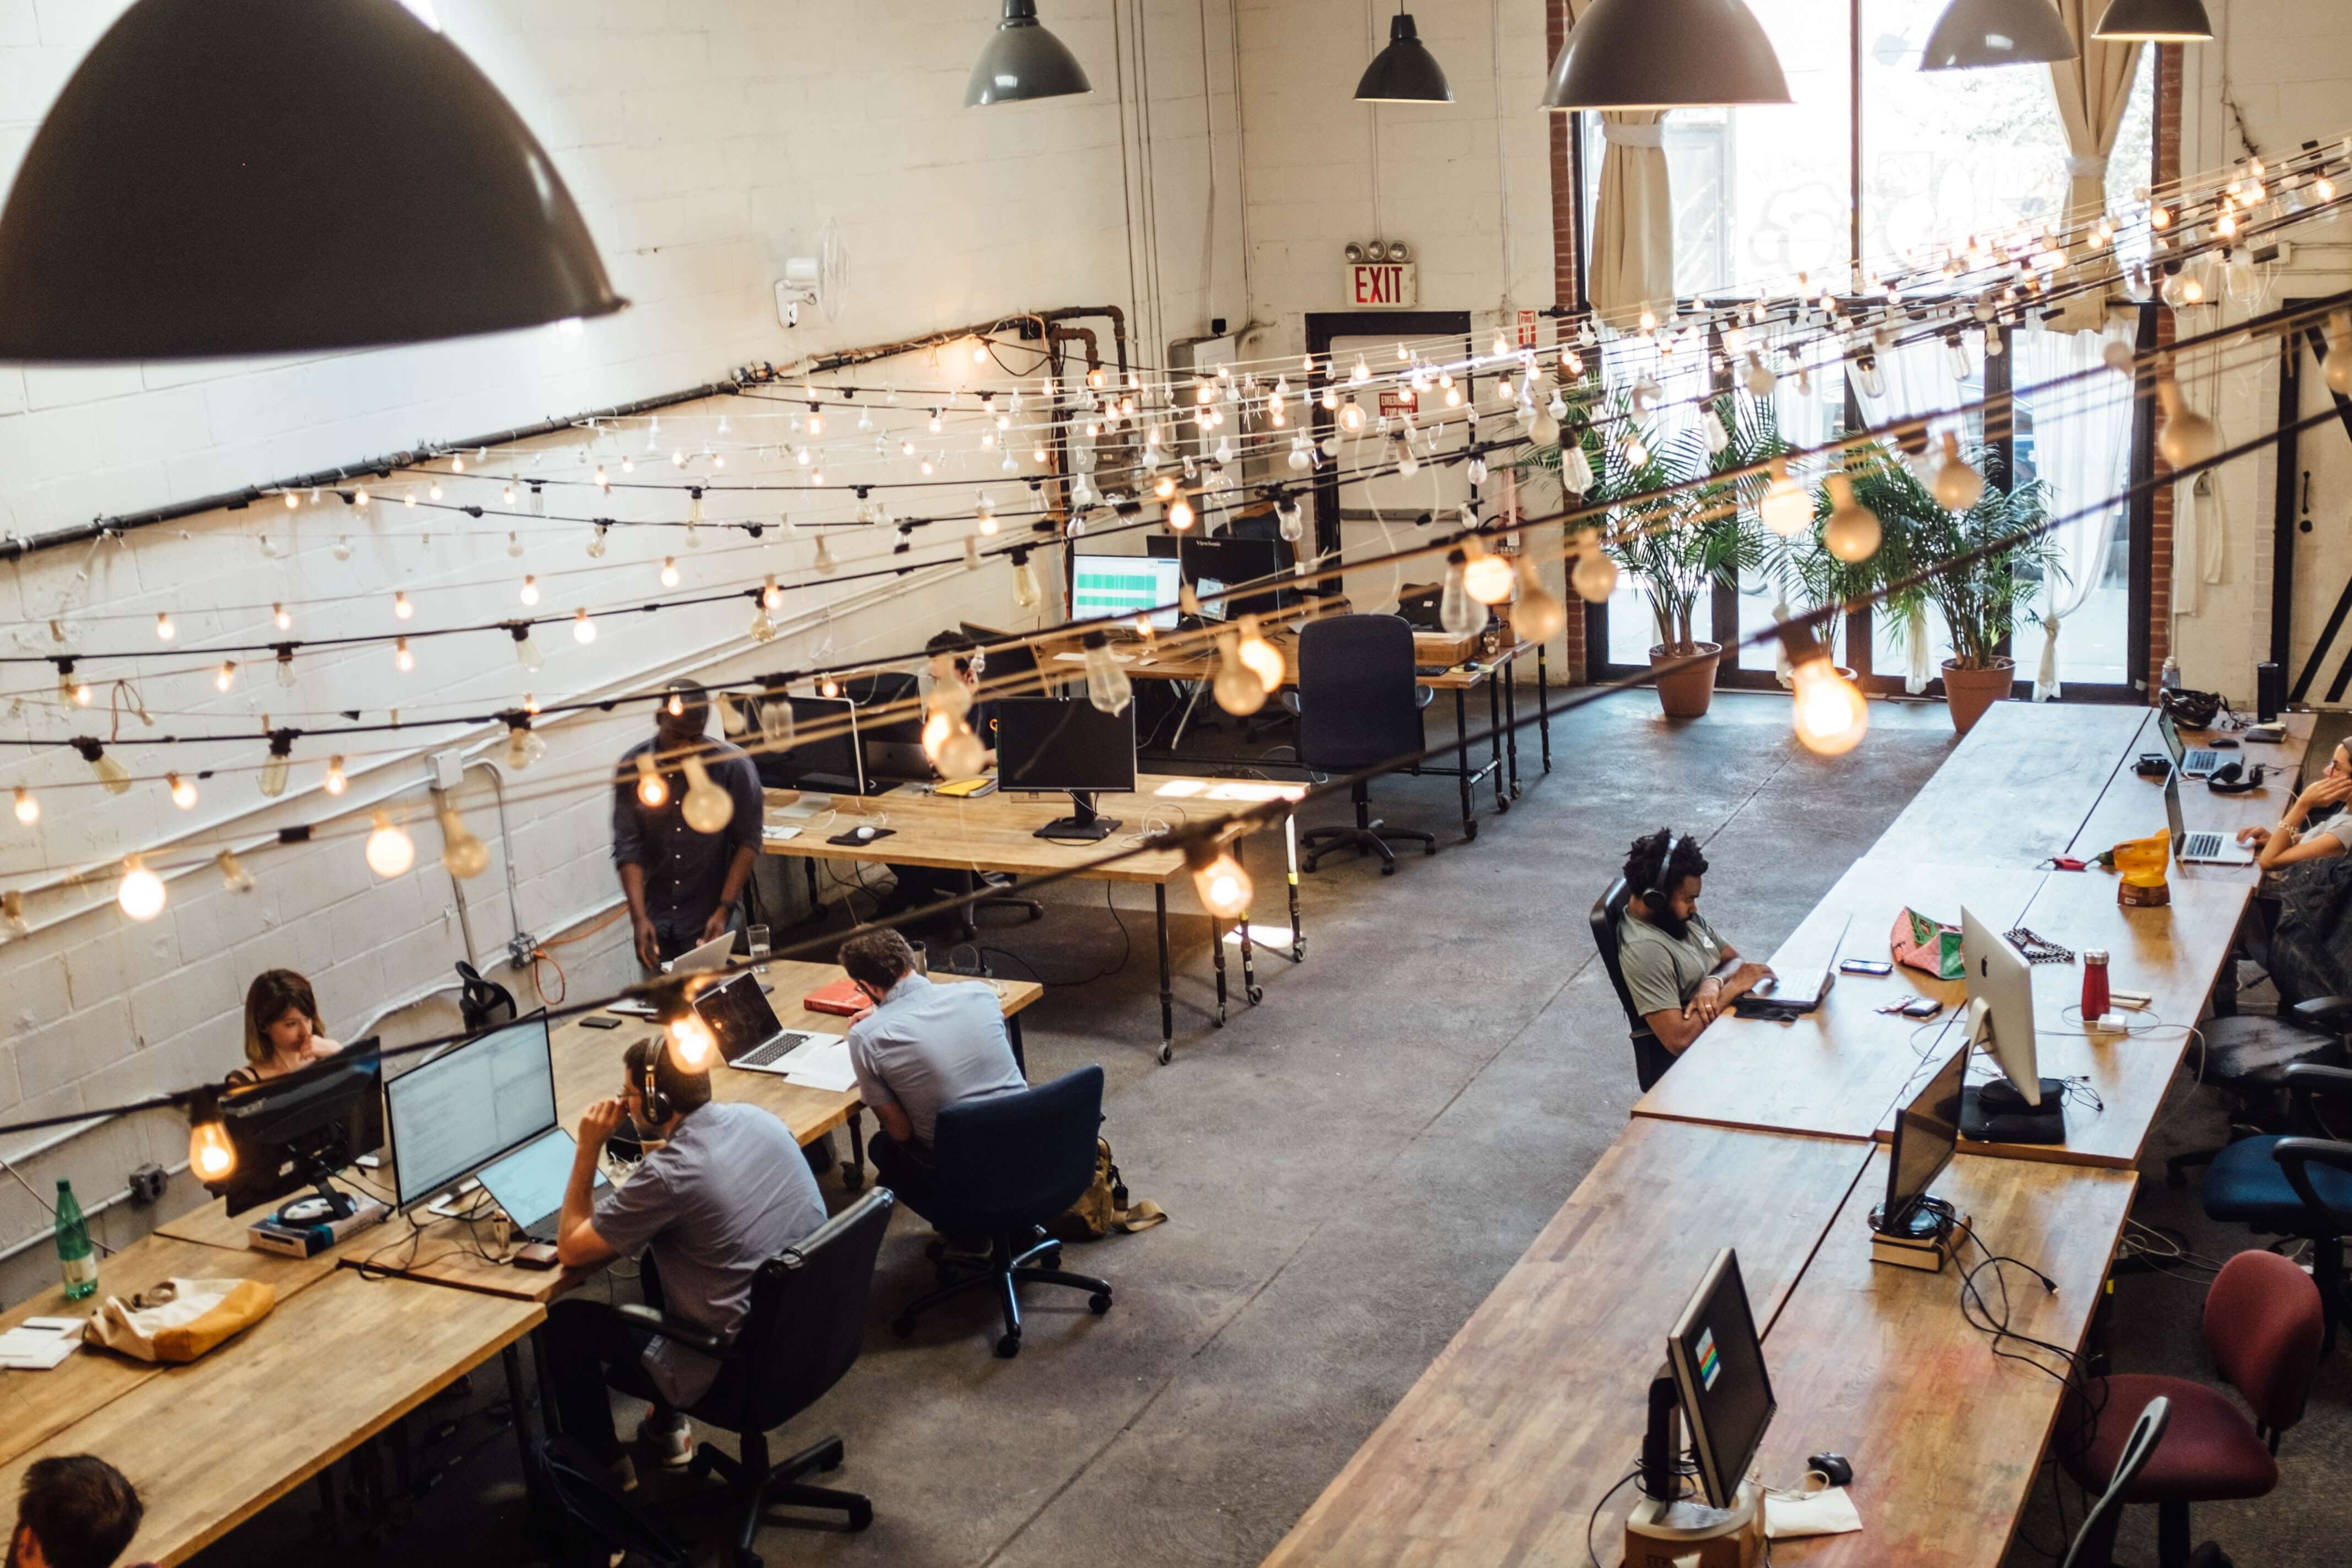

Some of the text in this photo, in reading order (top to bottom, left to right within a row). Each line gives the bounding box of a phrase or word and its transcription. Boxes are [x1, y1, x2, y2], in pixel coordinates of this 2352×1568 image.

[1355, 267, 1402, 303] EXIT
[1381, 395, 1415, 406] EMERGCY
[1385, 408, 1397, 417] EXIT
